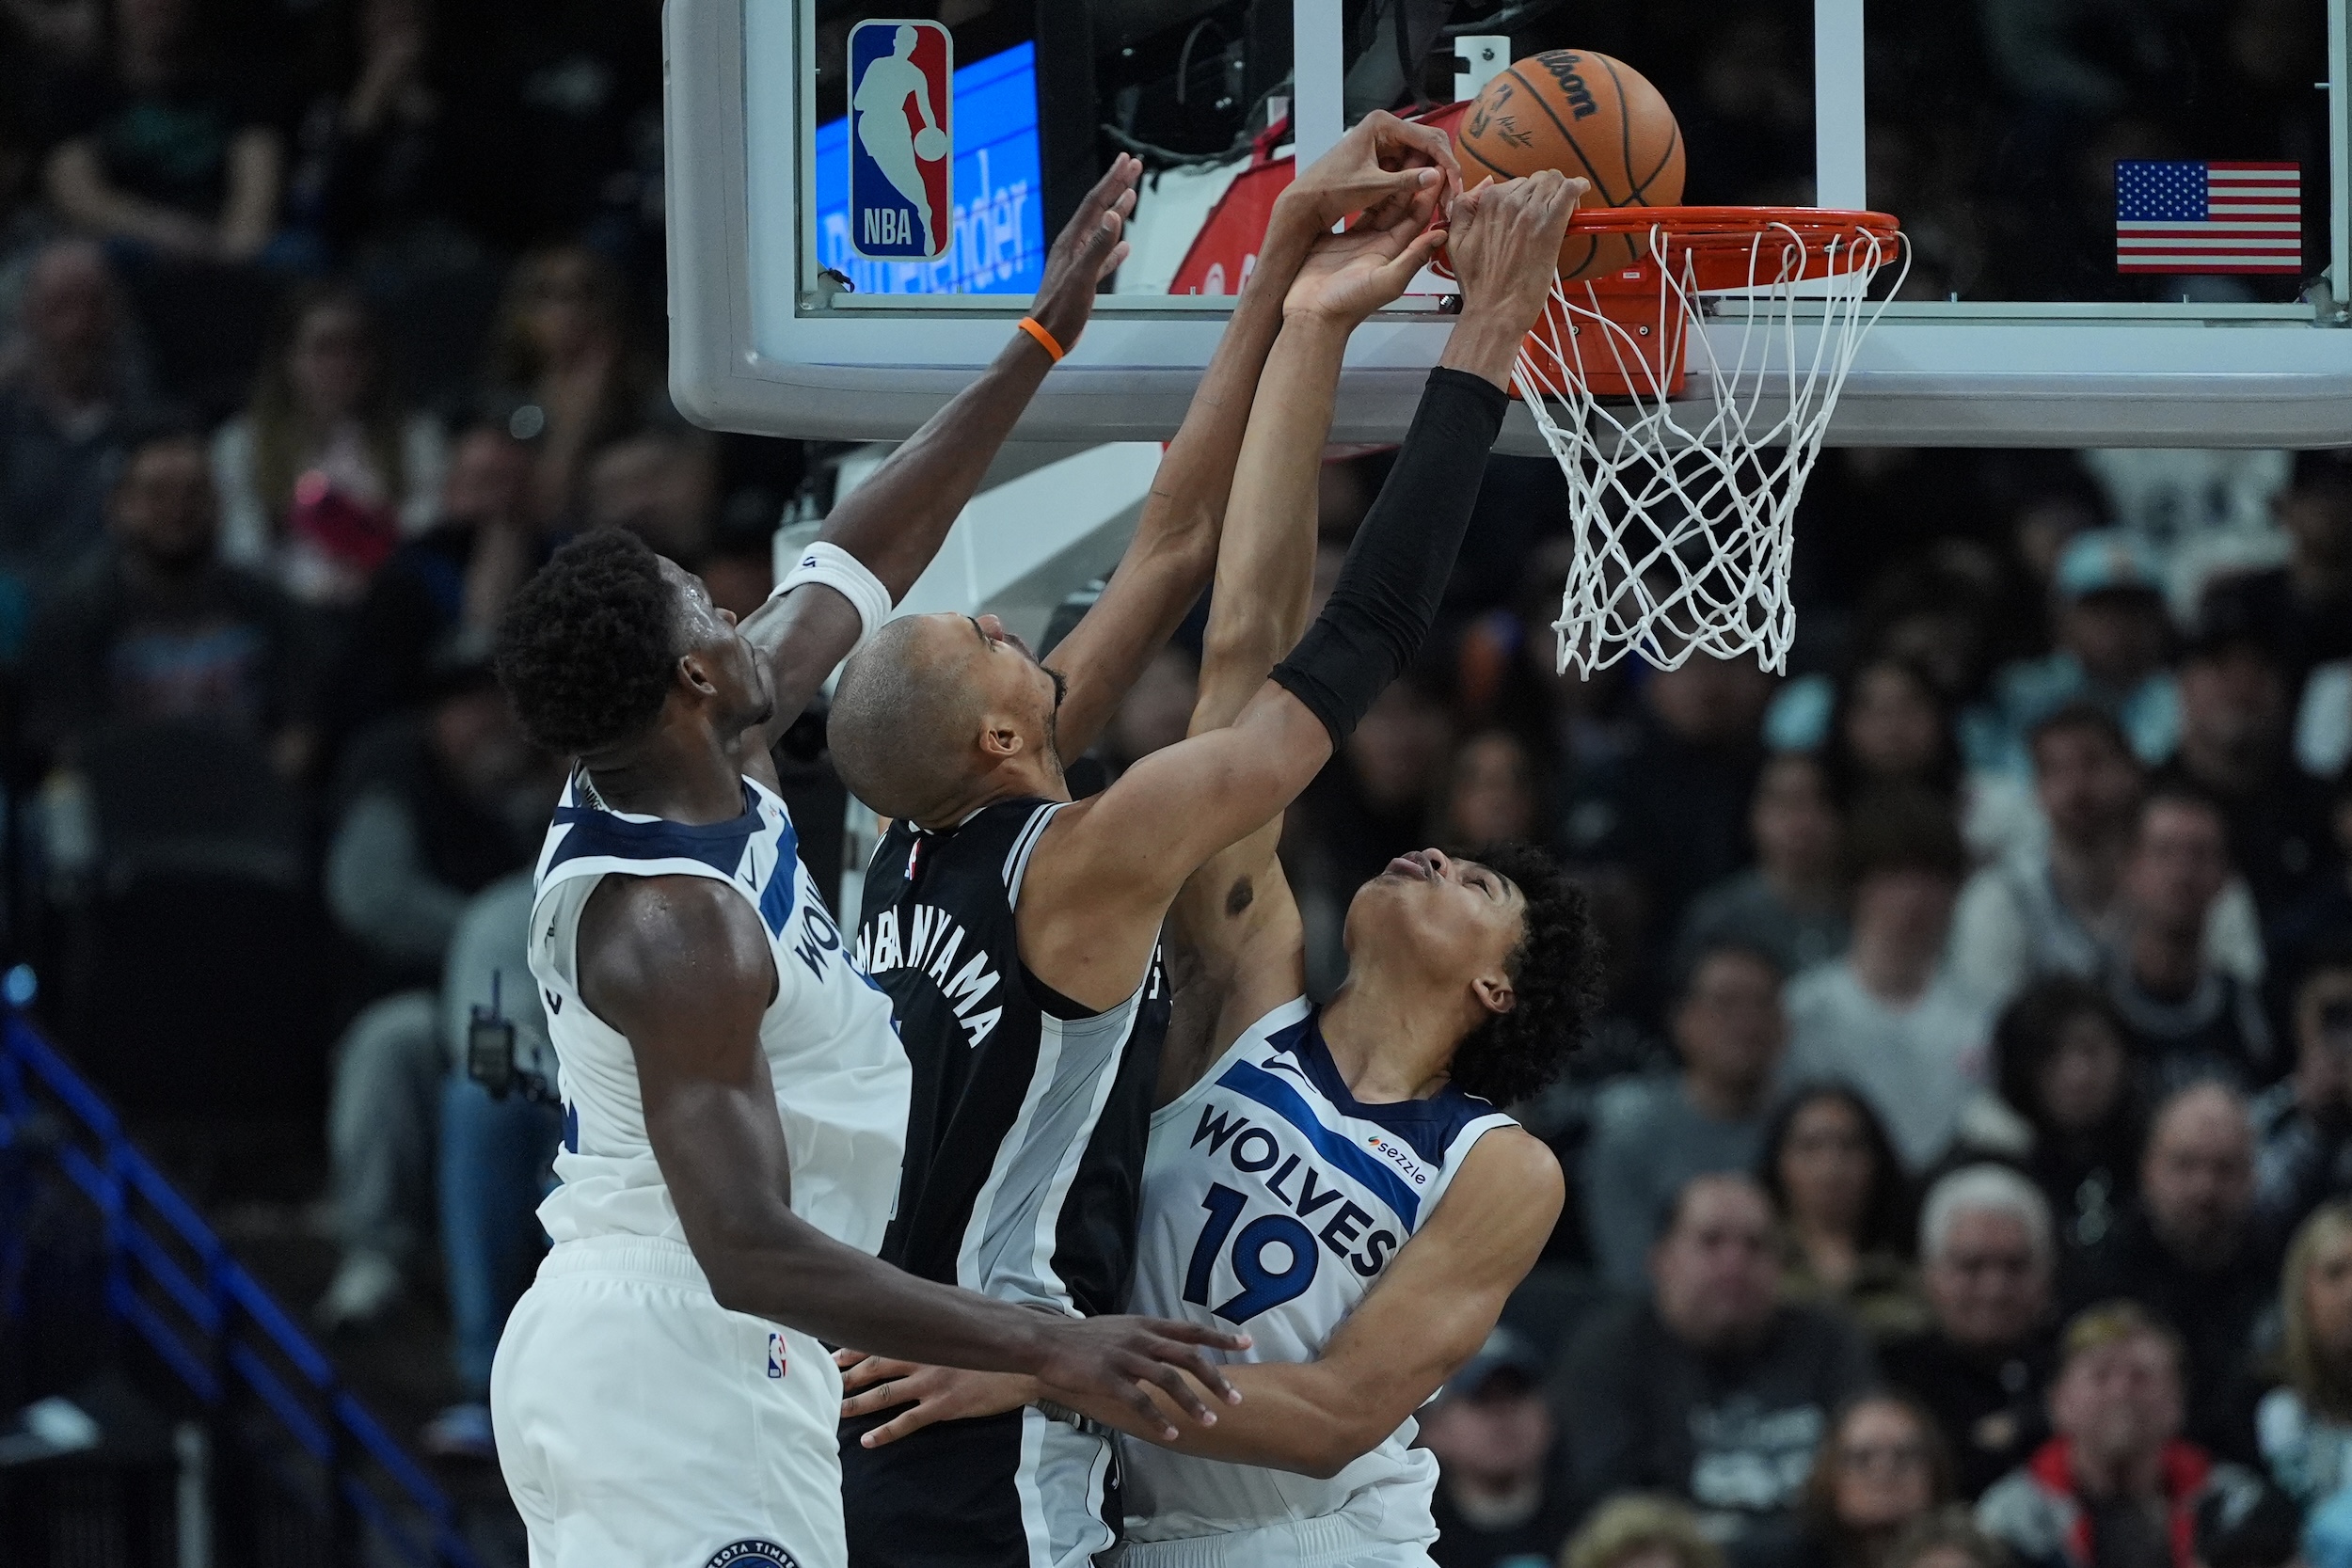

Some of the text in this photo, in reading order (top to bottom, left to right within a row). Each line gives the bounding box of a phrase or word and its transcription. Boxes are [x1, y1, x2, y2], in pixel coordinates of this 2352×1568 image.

[864, 207, 913, 245] NBA
[1189, 1103, 1397, 1277] WOLVES
[1377, 1142, 1426, 1185] sezzle
[1182, 1181, 1319, 1326] 19
